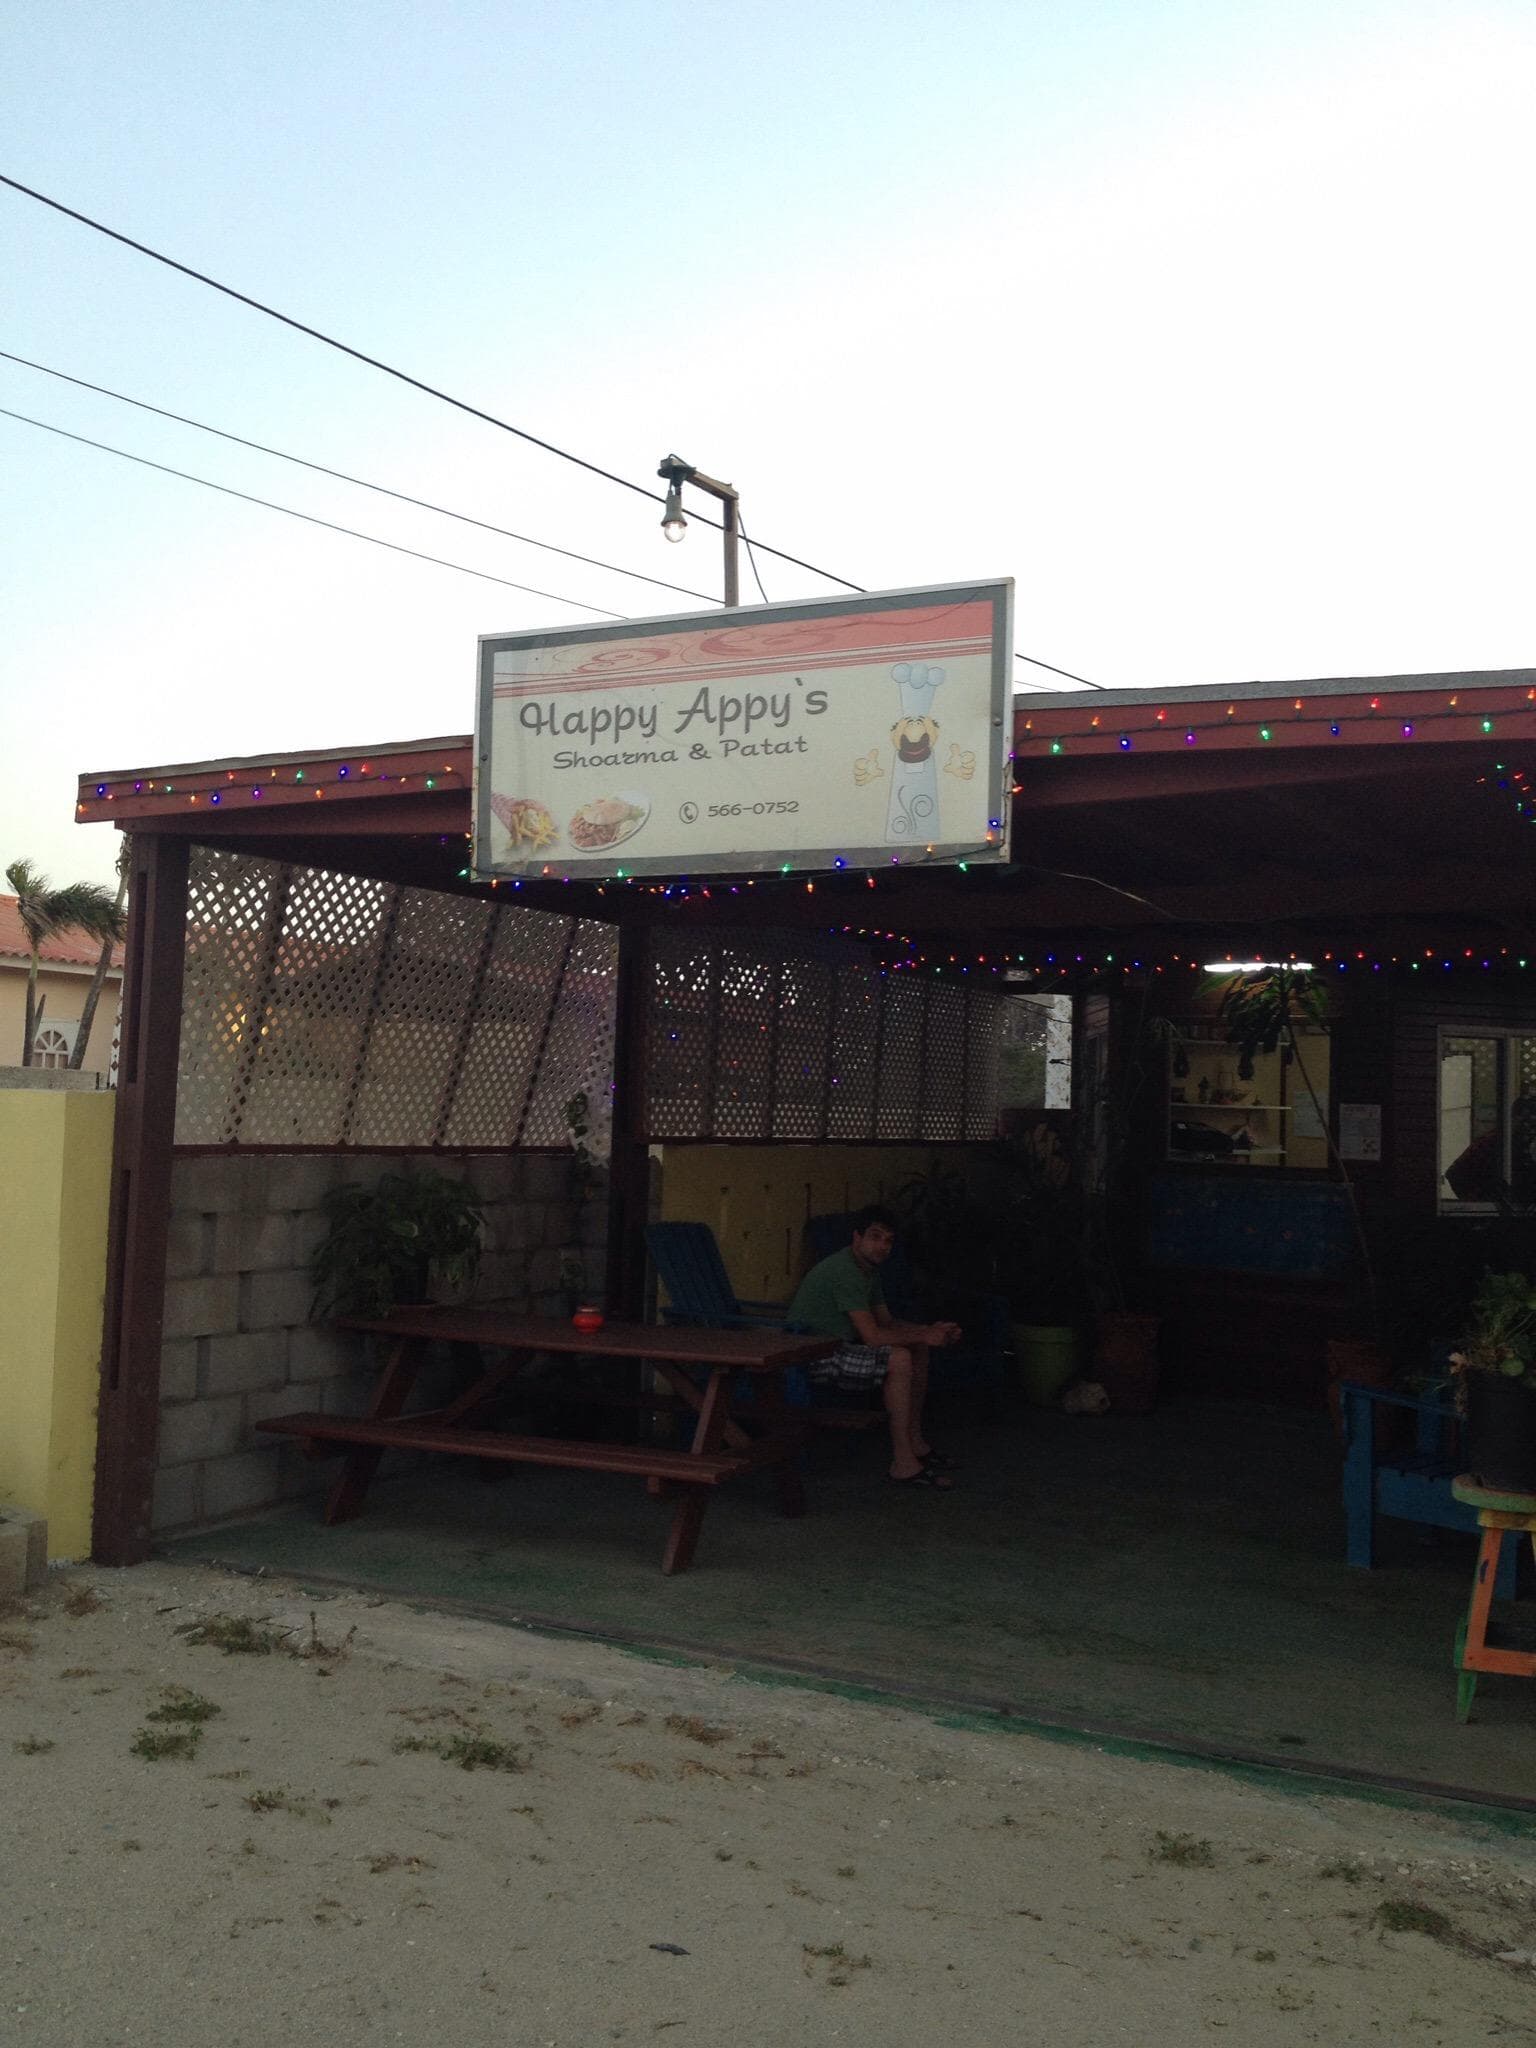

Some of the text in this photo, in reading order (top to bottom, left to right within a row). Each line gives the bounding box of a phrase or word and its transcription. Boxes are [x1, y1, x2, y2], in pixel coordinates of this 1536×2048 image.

[519, 701, 658, 746] Happy
[552, 736, 809, 770] Shoarma & Patat
[707, 800, 800, 818] 566-0752
